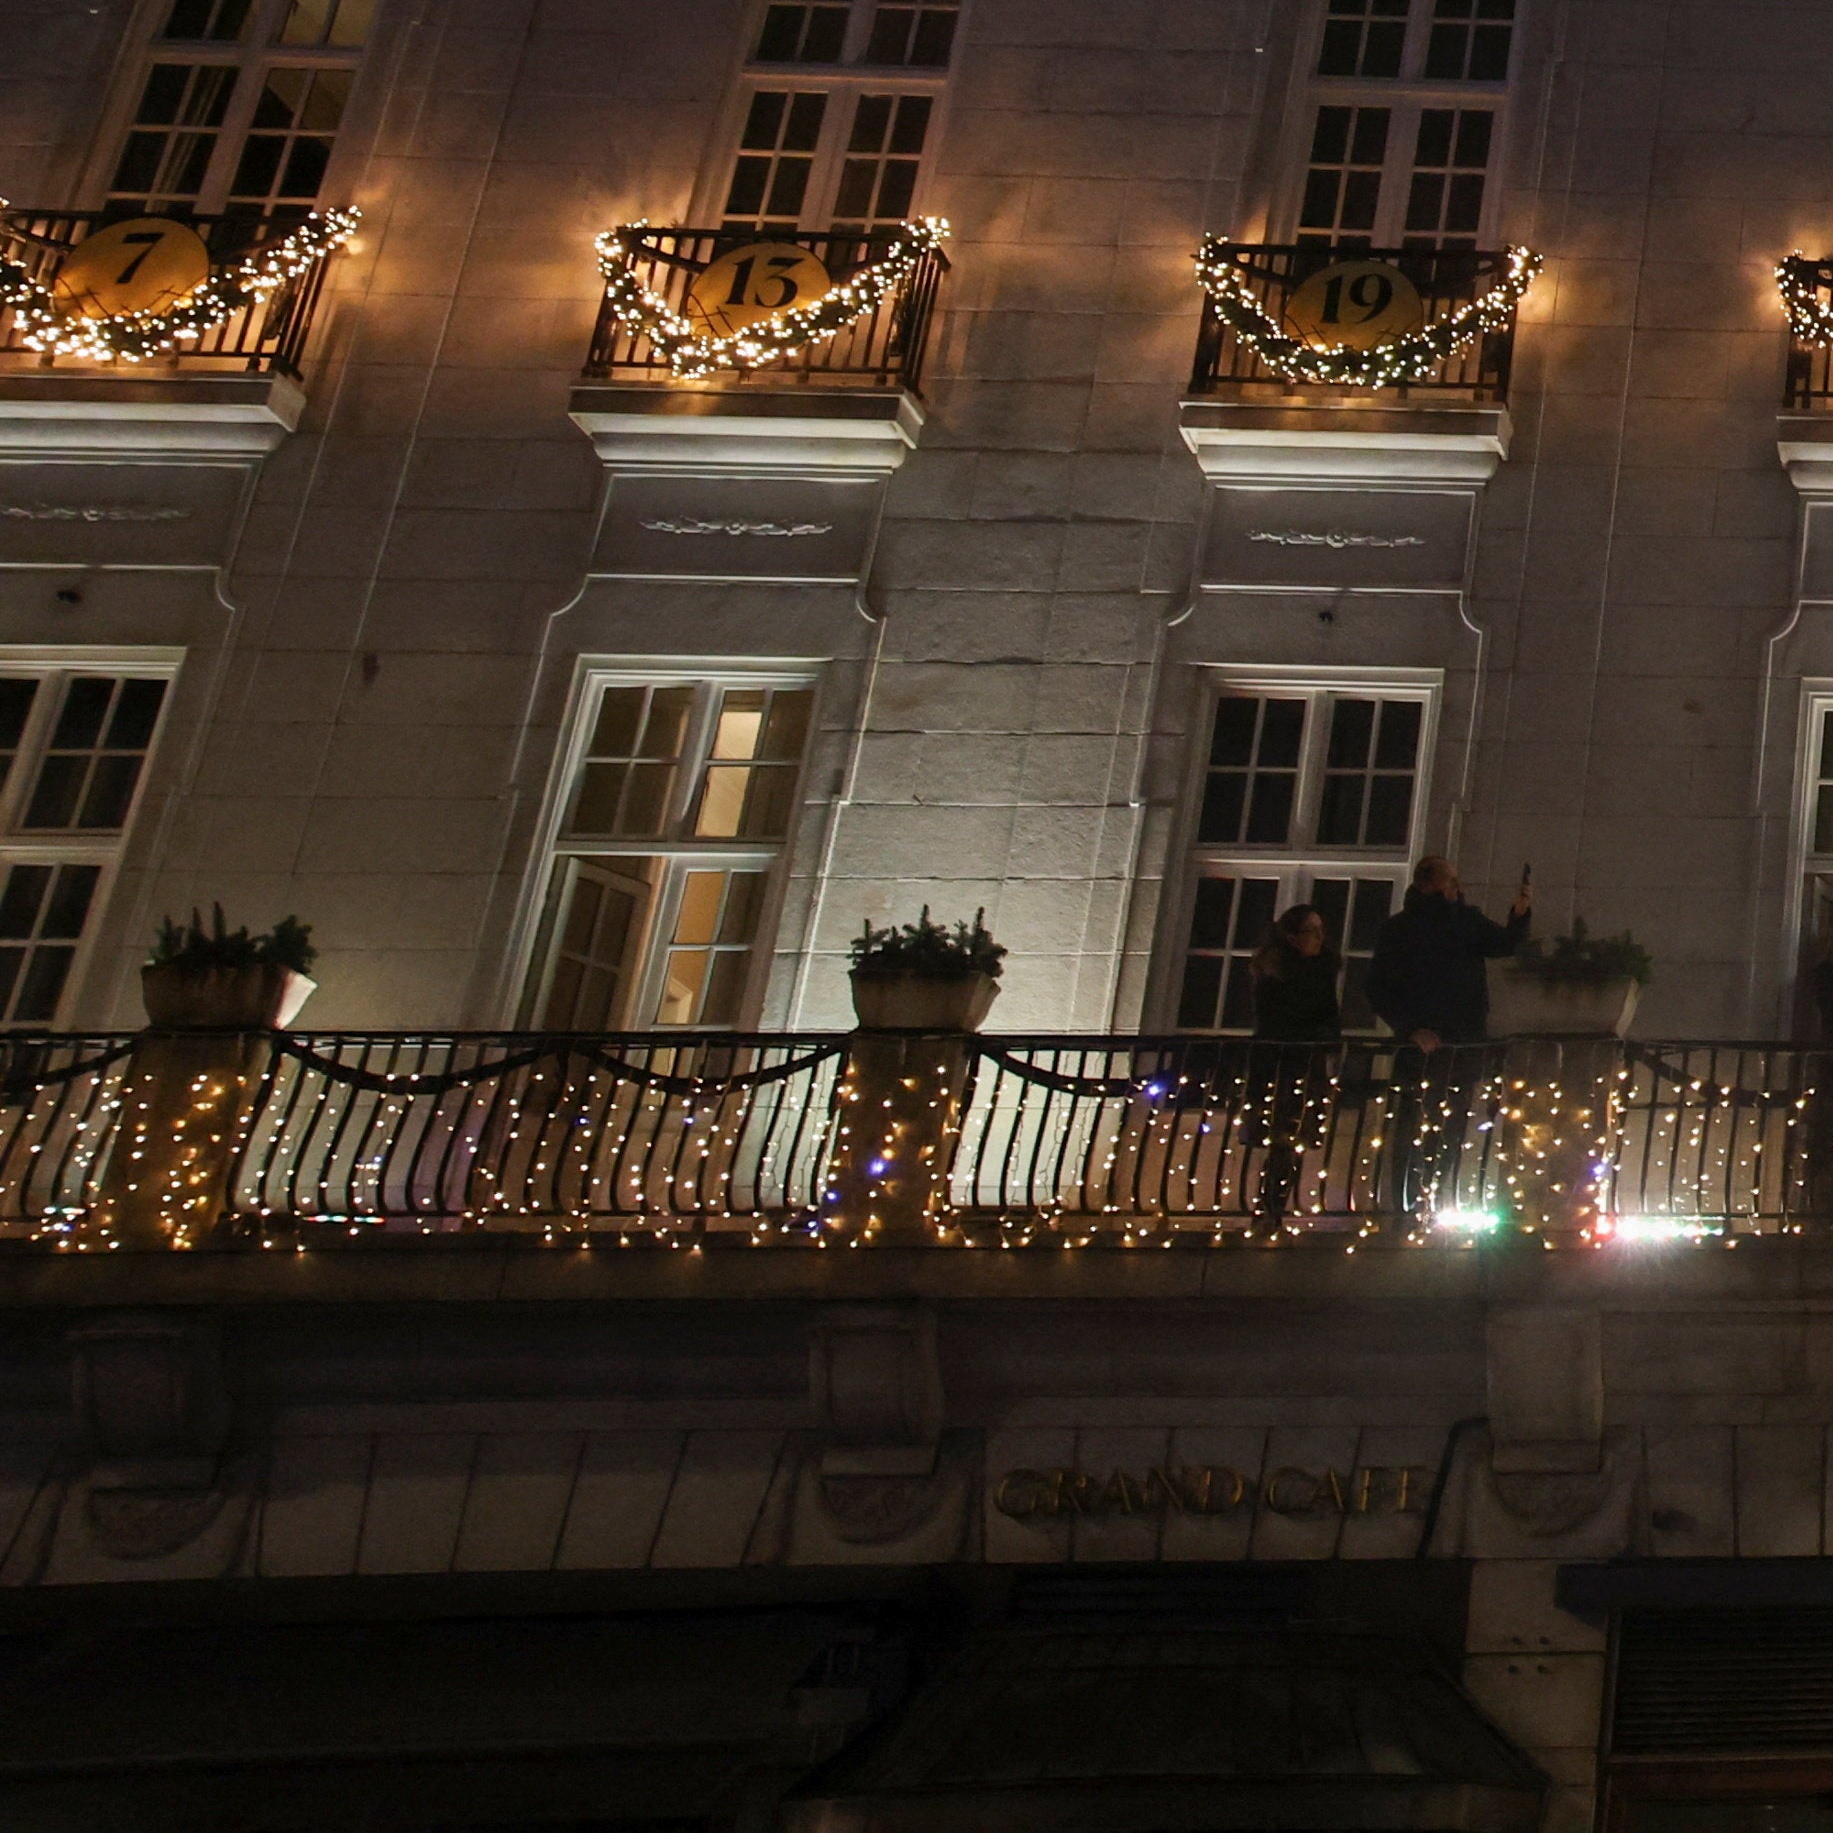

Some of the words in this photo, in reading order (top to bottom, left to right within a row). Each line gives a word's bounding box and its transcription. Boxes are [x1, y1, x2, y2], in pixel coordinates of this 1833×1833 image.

[116, 232, 165, 284] 7
[724, 254, 803, 308] 13
[1320, 273, 1393, 325] 19
[993, 1465, 1246, 1518] GRAND
